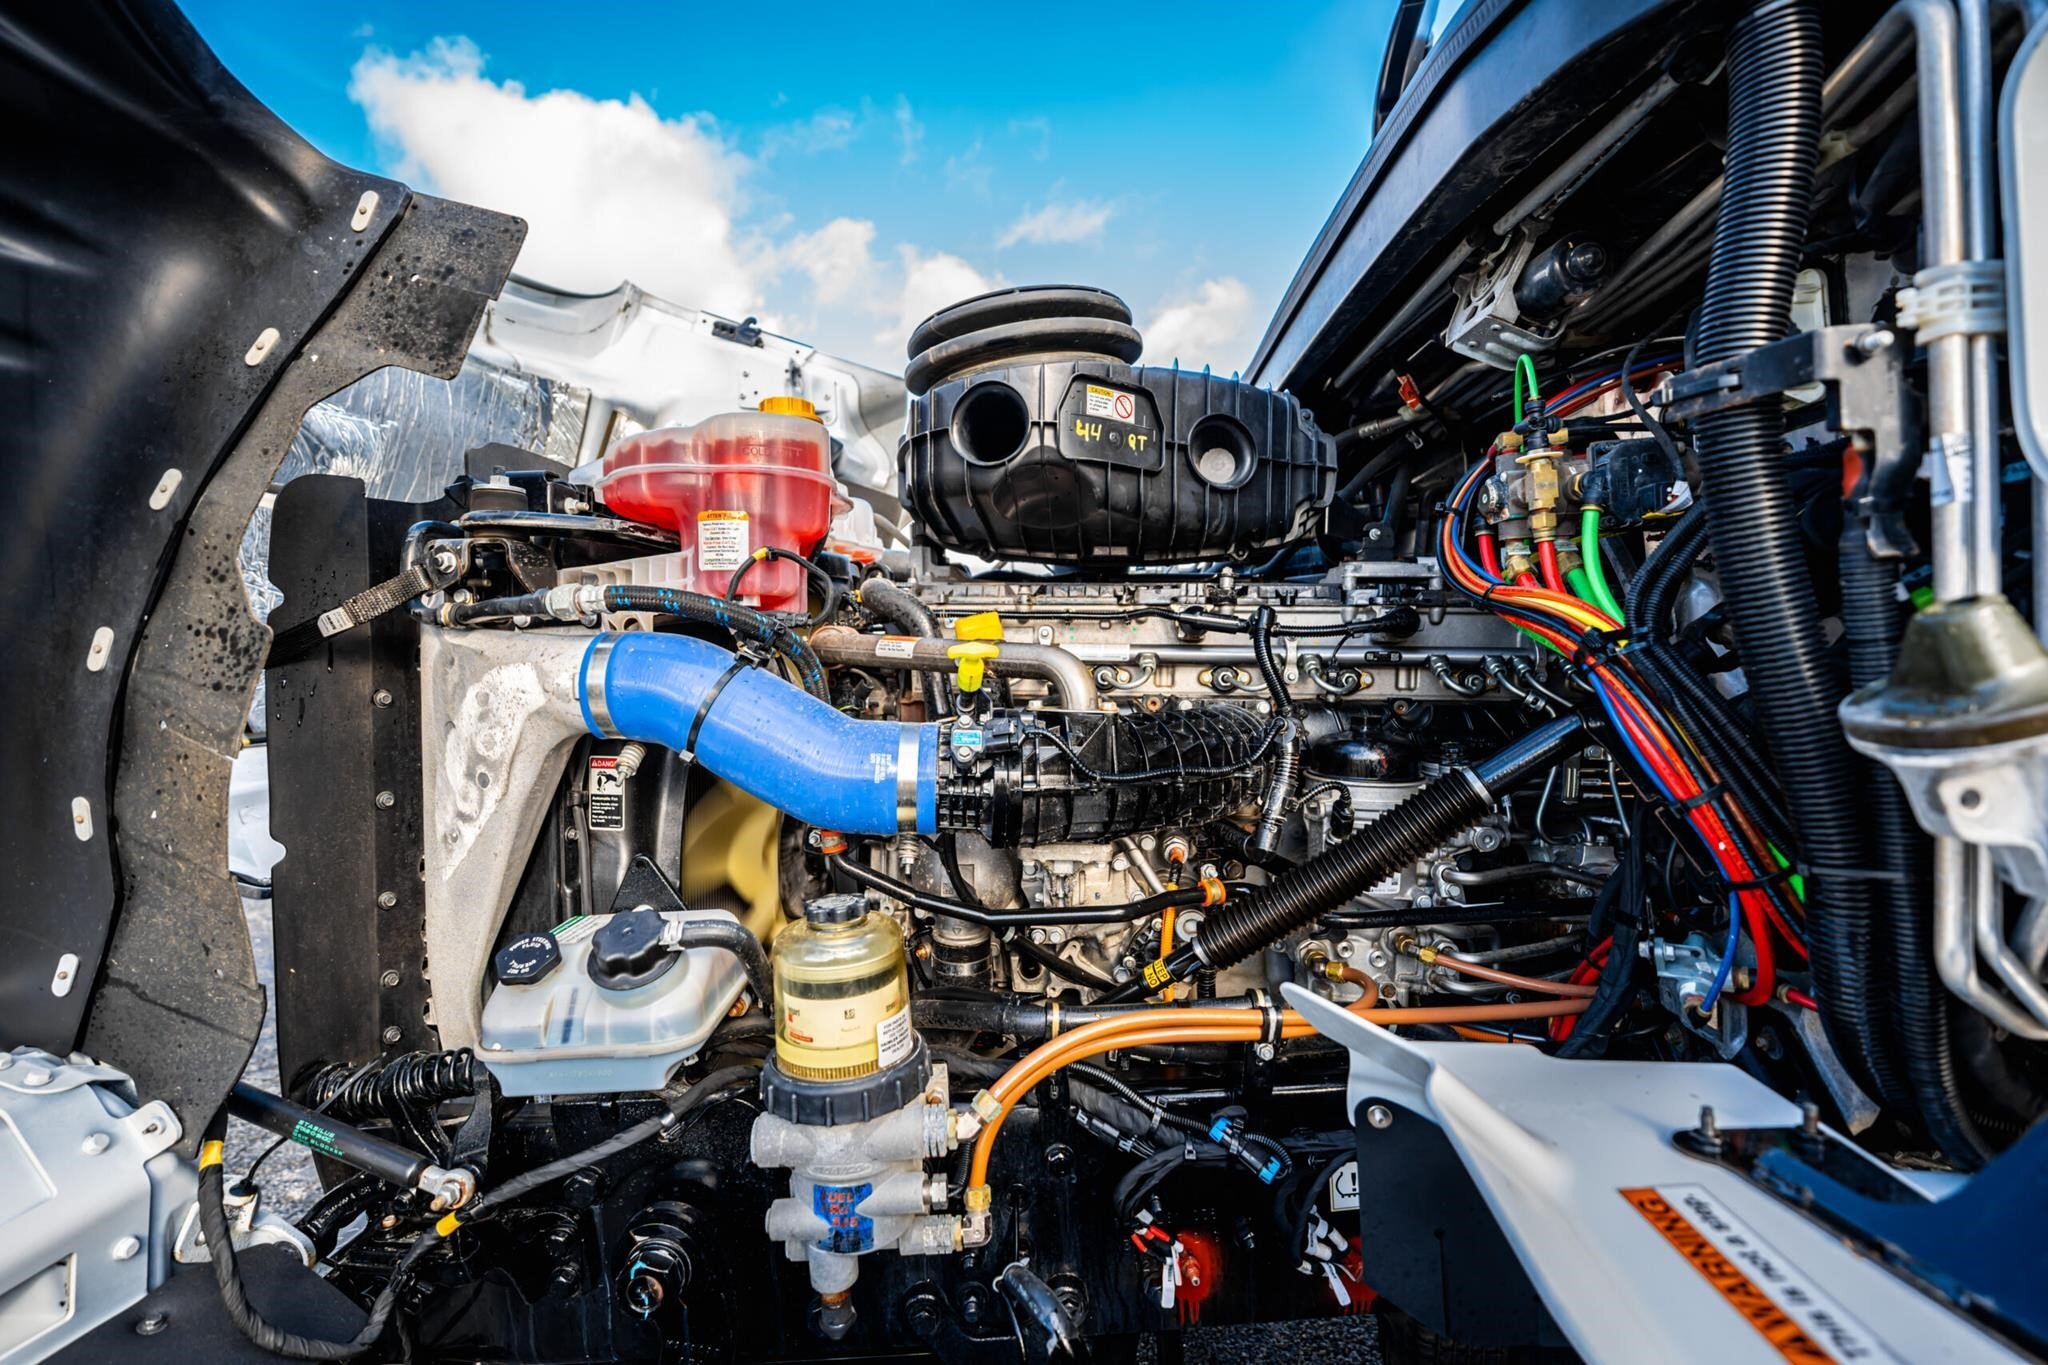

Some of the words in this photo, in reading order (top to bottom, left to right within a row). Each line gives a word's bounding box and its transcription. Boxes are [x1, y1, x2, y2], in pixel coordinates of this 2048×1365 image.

[596, 759, 617, 768] DANG
[509, 938, 530, 951] POWER
[532, 936, 552, 950] STEERING
[1154, 960, 1169, 979] STEP
[298, 1119, 336, 1139] STABILUS
[1725, 1234, 1749, 1248] a
[1637, 1197, 1792, 1332] WARNING
[1737, 1250, 1788, 1283] not
[1781, 1285, 1812, 1307] is
[1807, 1308, 1868, 1360] This
